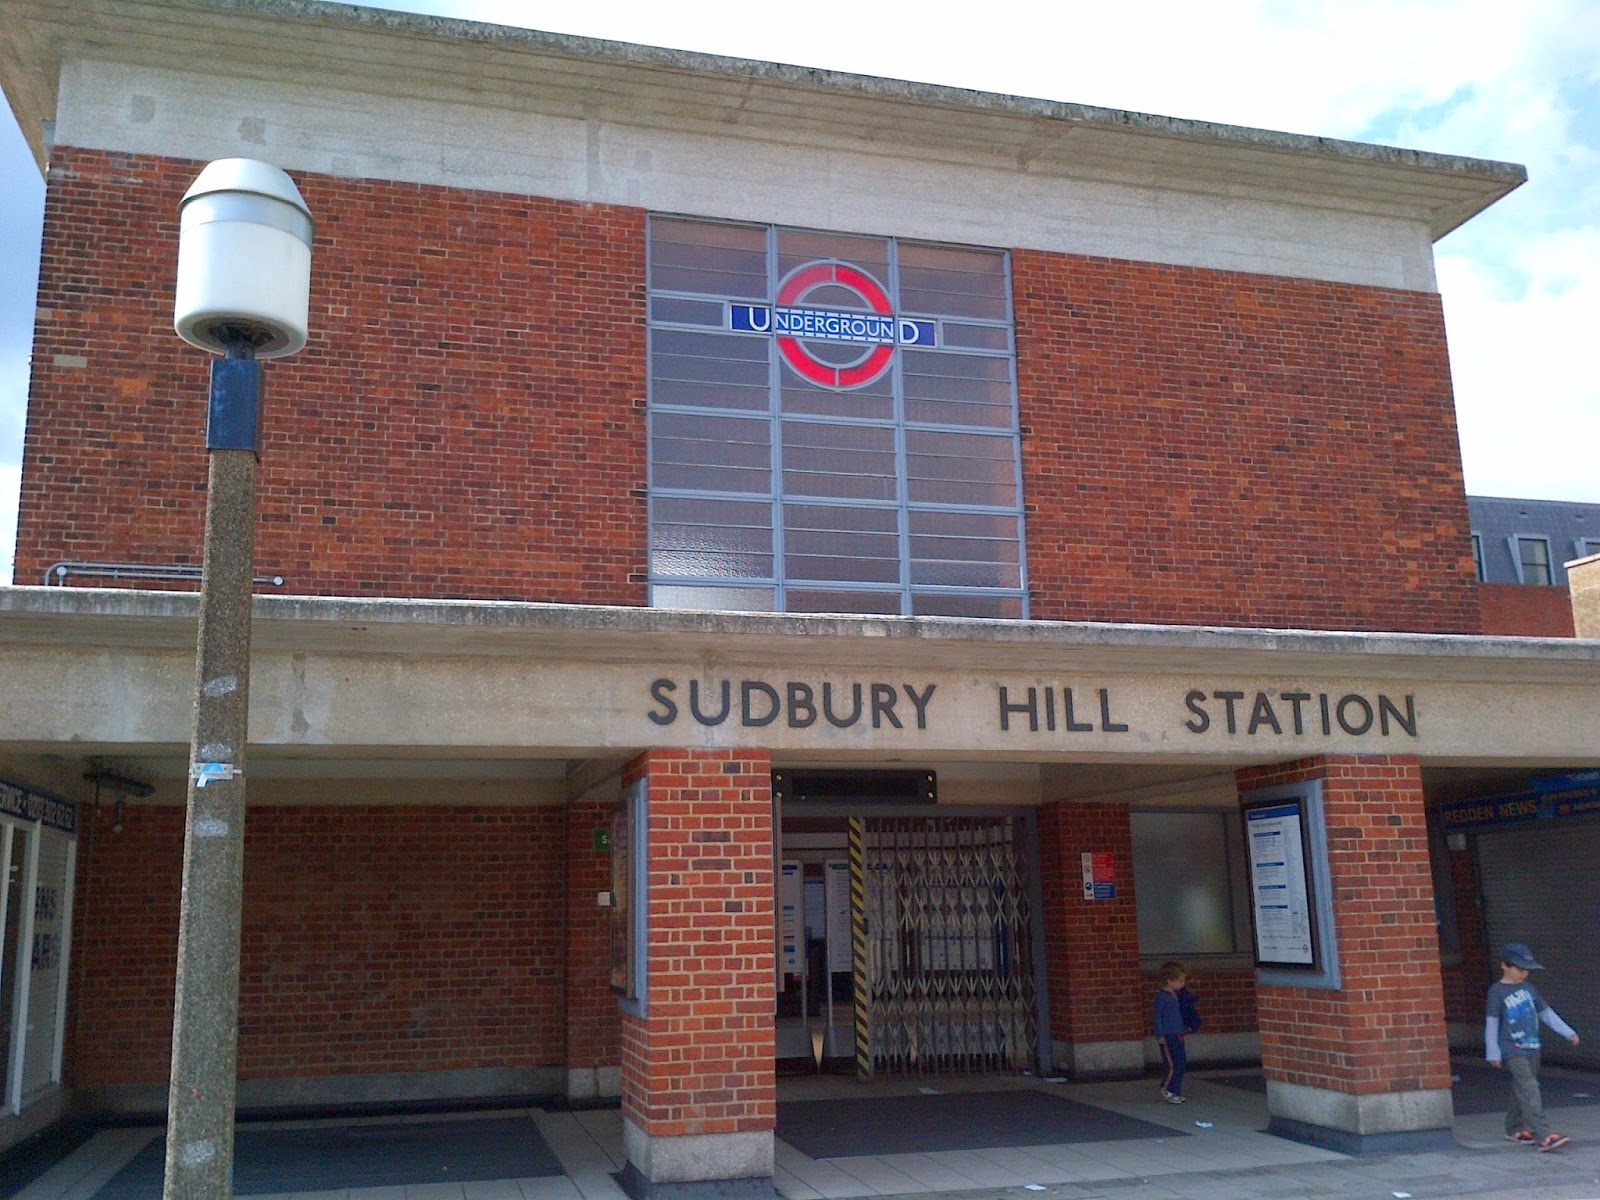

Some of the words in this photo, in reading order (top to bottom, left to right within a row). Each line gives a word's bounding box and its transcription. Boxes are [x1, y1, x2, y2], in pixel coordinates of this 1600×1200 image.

[749, 305, 920, 345] UNDERGROUND
[647, 678, 937, 730] SUDBURY
[999, 685, 1129, 732] HILL
[1184, 689, 1417, 737] STATION
[1499, 800, 1537, 817] NEWS
